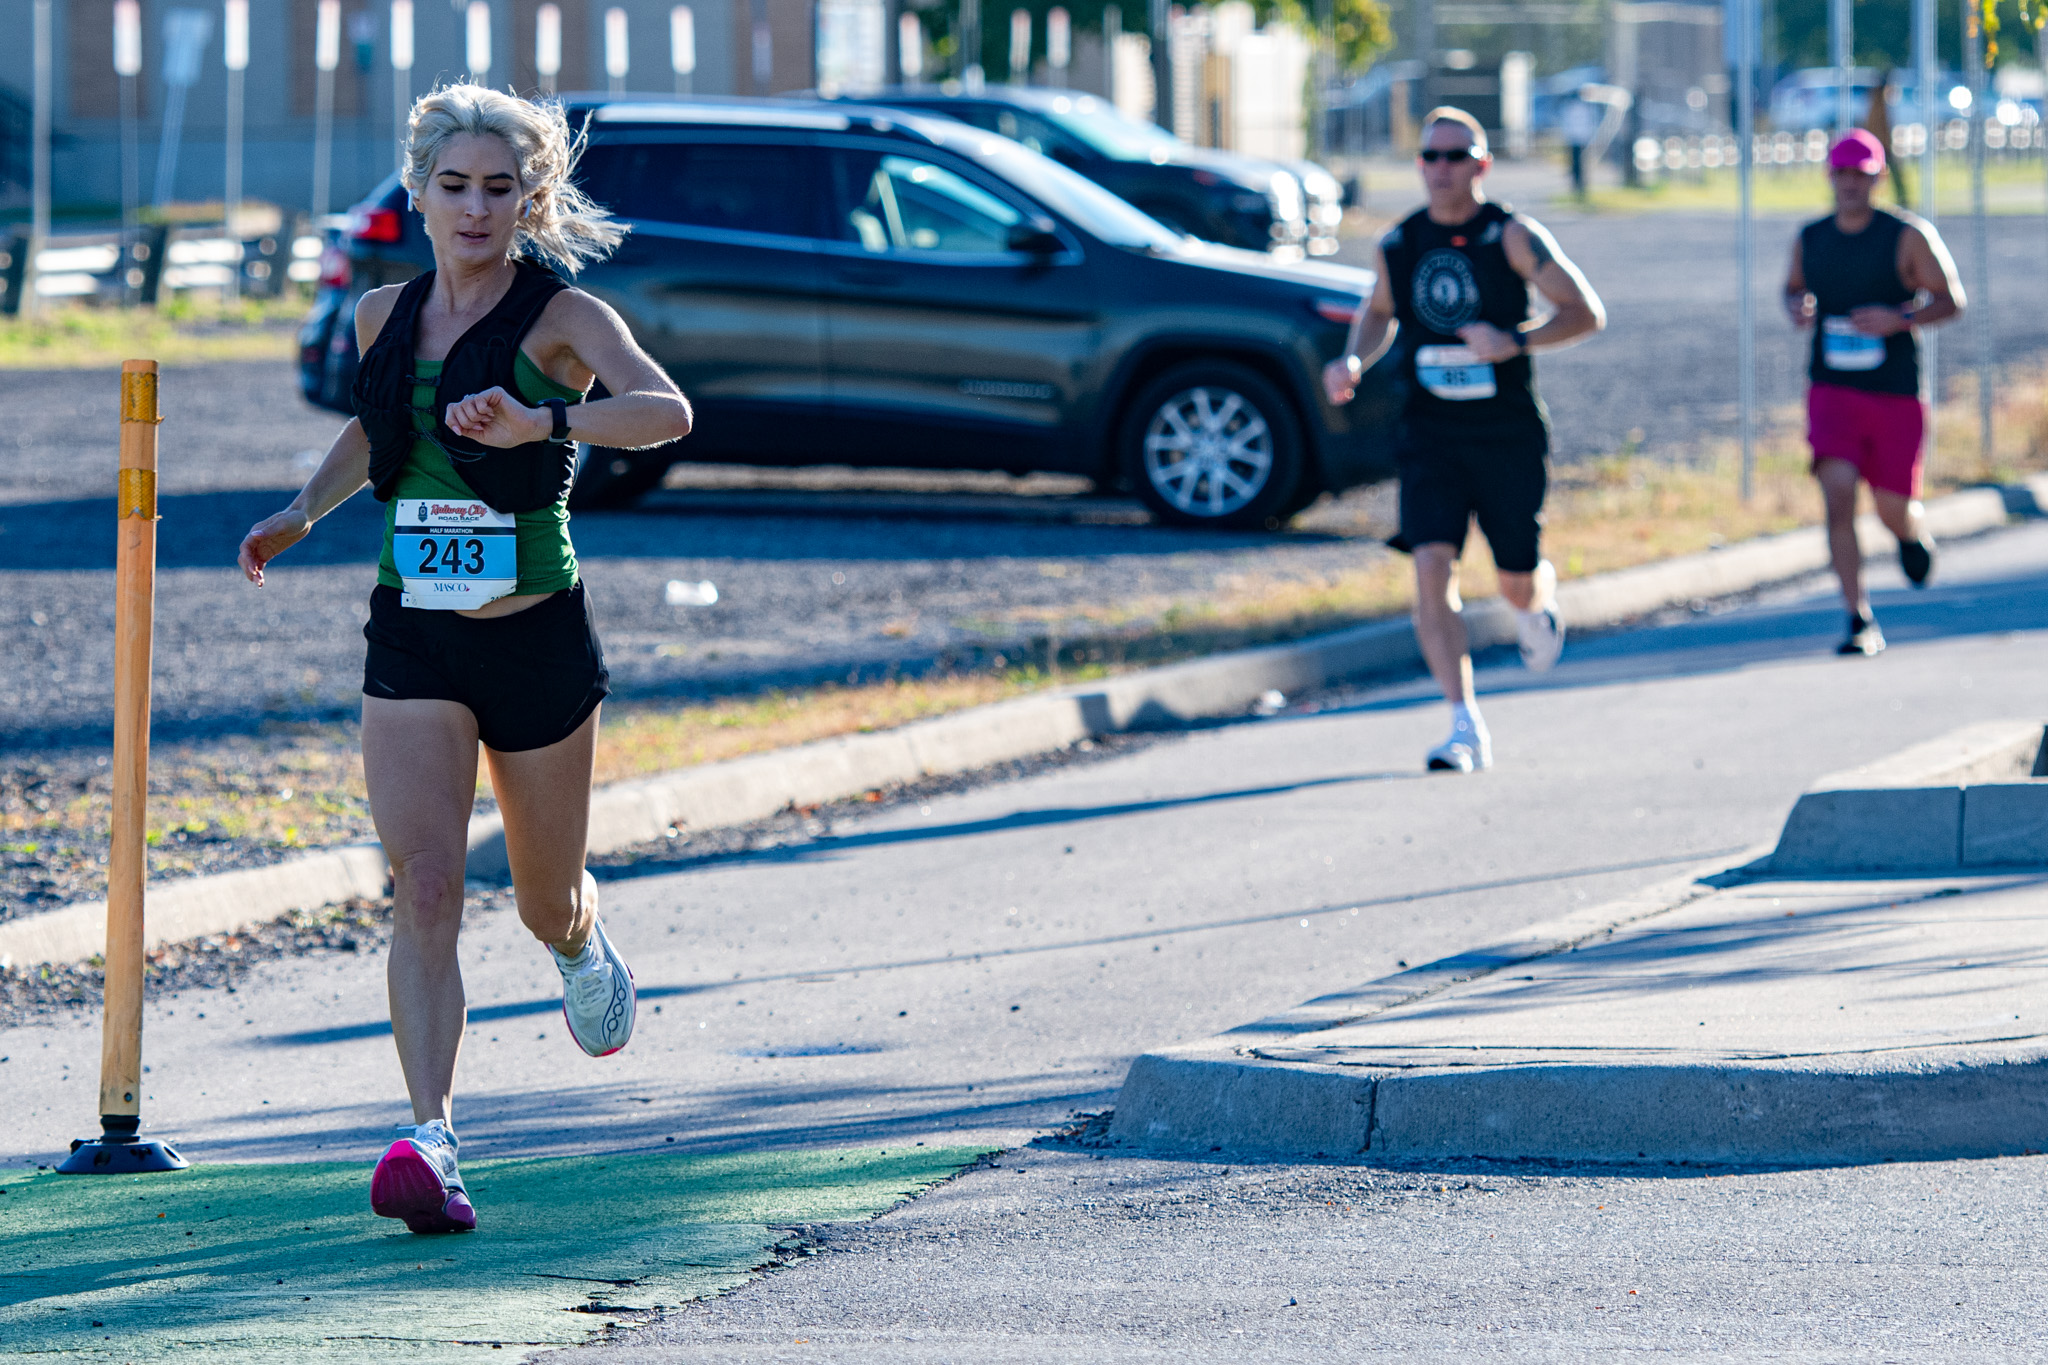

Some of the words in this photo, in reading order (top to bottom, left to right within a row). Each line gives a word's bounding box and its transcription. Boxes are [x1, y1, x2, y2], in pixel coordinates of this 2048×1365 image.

[430, 504, 468, 517] Railway
[468, 504, 488, 517] City
[419, 538, 484, 574] 243
[433, 583, 467, 592] MASCO
